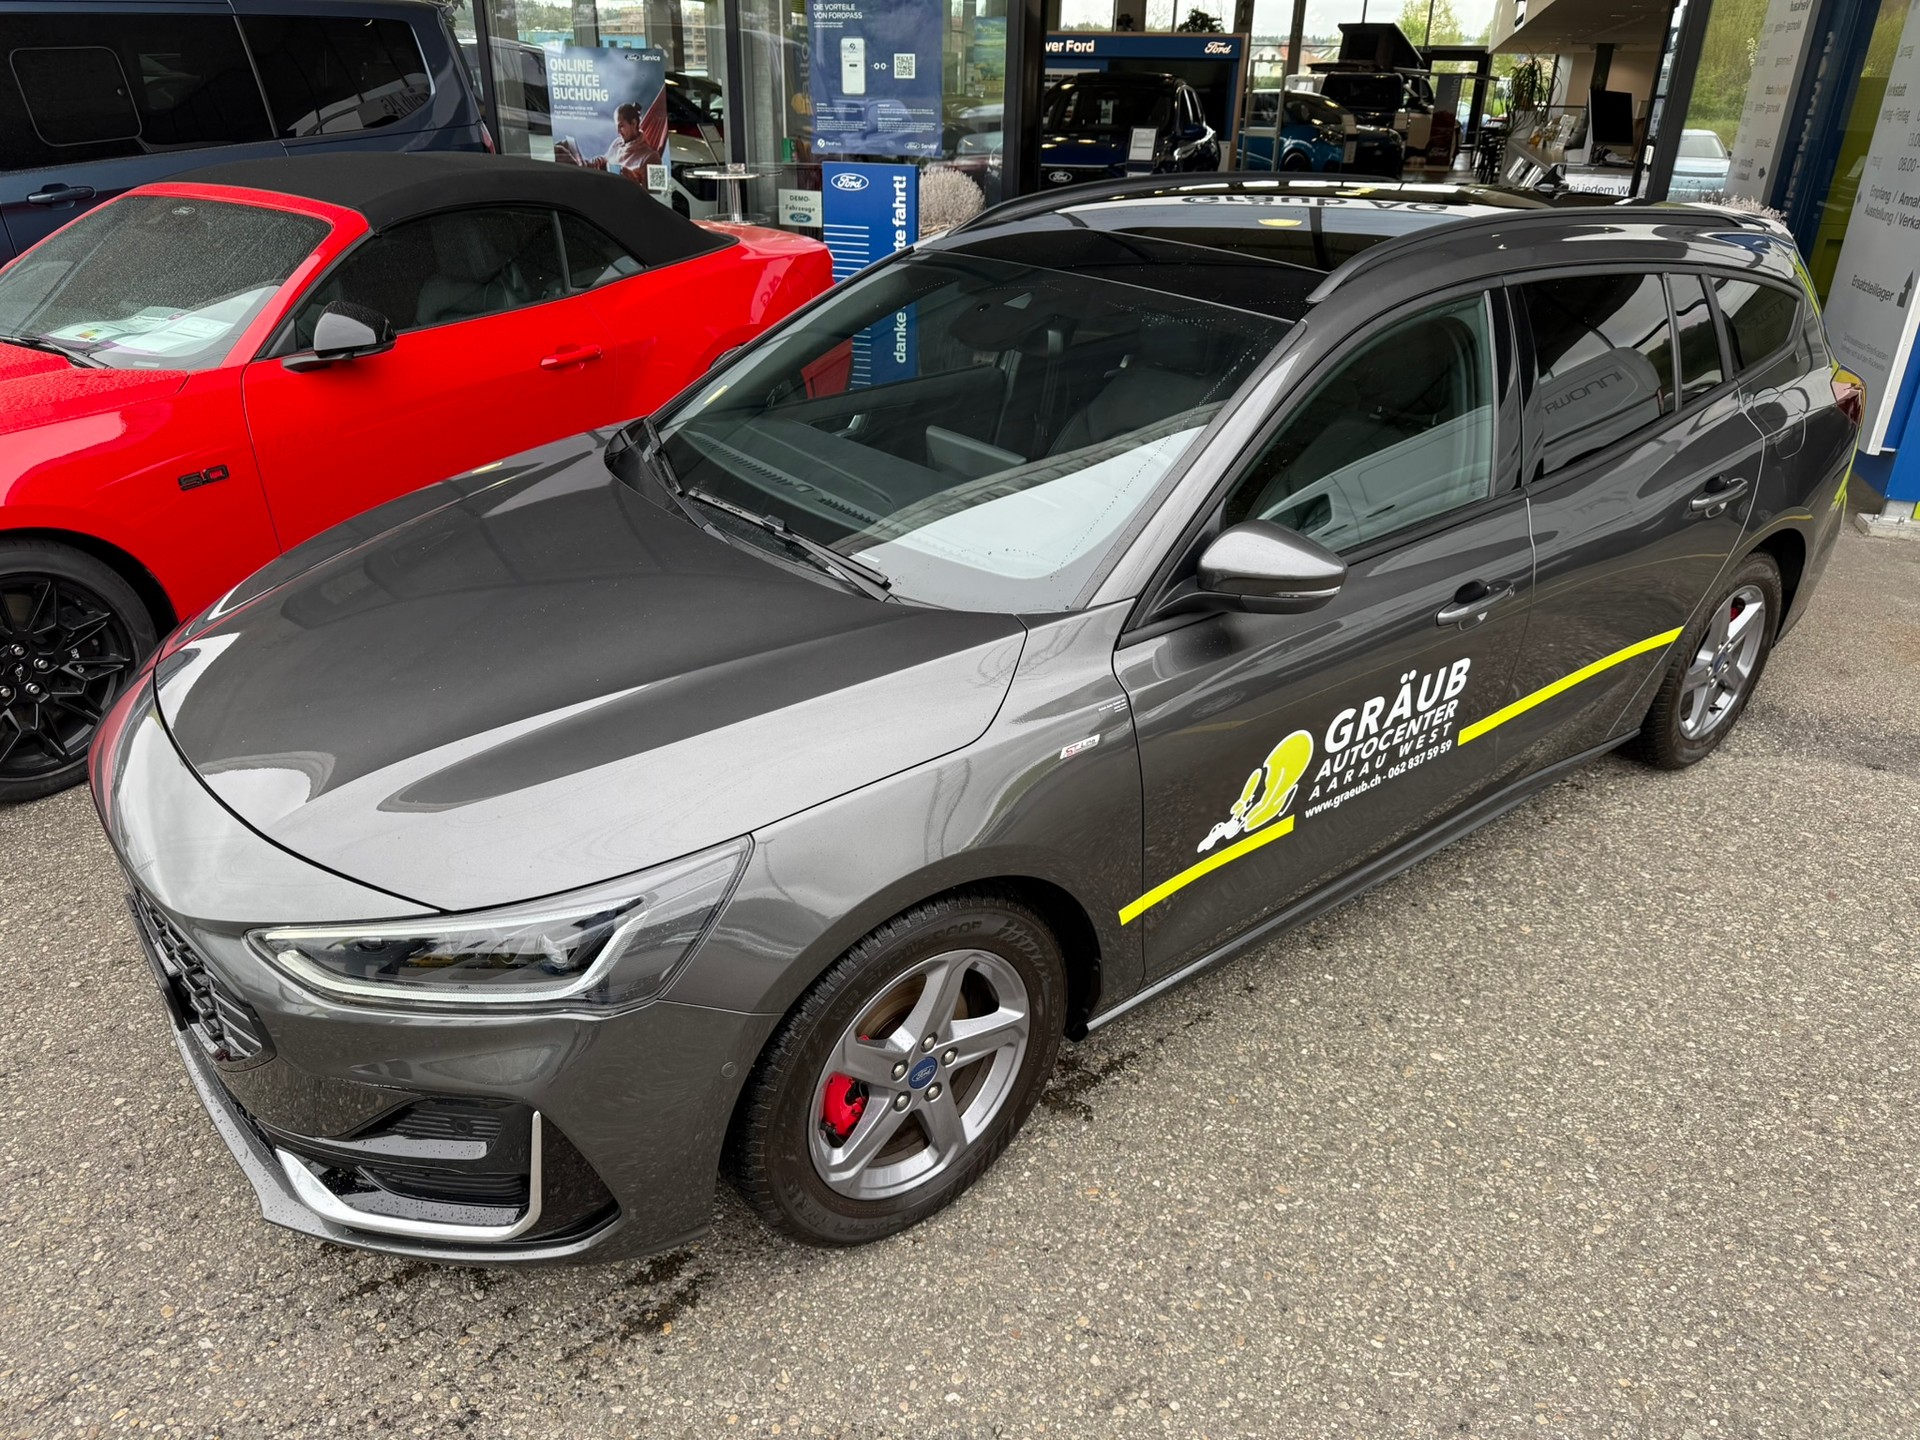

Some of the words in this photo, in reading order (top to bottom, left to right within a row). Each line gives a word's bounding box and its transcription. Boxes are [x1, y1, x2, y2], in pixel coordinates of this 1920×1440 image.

[813, 3, 824, 11] DIE
[825, 3, 856, 11] VORTEILE
[813, 11, 828, 19] VON
[828, 11, 863, 19] FORDPASS
[1066, 40, 1095, 52] Ford
[1204, 41, 1232, 54] Ford
[549, 58, 594, 73] ONLINE
[551, 73, 600, 87] SERVICE
[553, 87, 609, 102] BUCHUNG
[837, 175, 863, 188] Ford
[892, 176, 906, 227] fahrt!
[1870, 184, 1891, 204] Empfang
[785, 204, 815, 213] Fahrzeuge
[1851, 275, 1895, 302] Ersatzteillager
[893, 312, 907, 363] danke
[1325, 657, 1471, 754] GRÄUB
[1314, 699, 1459, 782] AUTOCENTER
[1308, 753, 1387, 801] AARAU
[1399, 722, 1453, 758] WEST
[1305, 774, 1382, 818] www.graeub.ch
[1388, 763, 1407, 779] 062
[1407, 752, 1426, 770] 837
[1426, 745, 1440, 761] 59
[1439, 738, 1453, 755] 59
